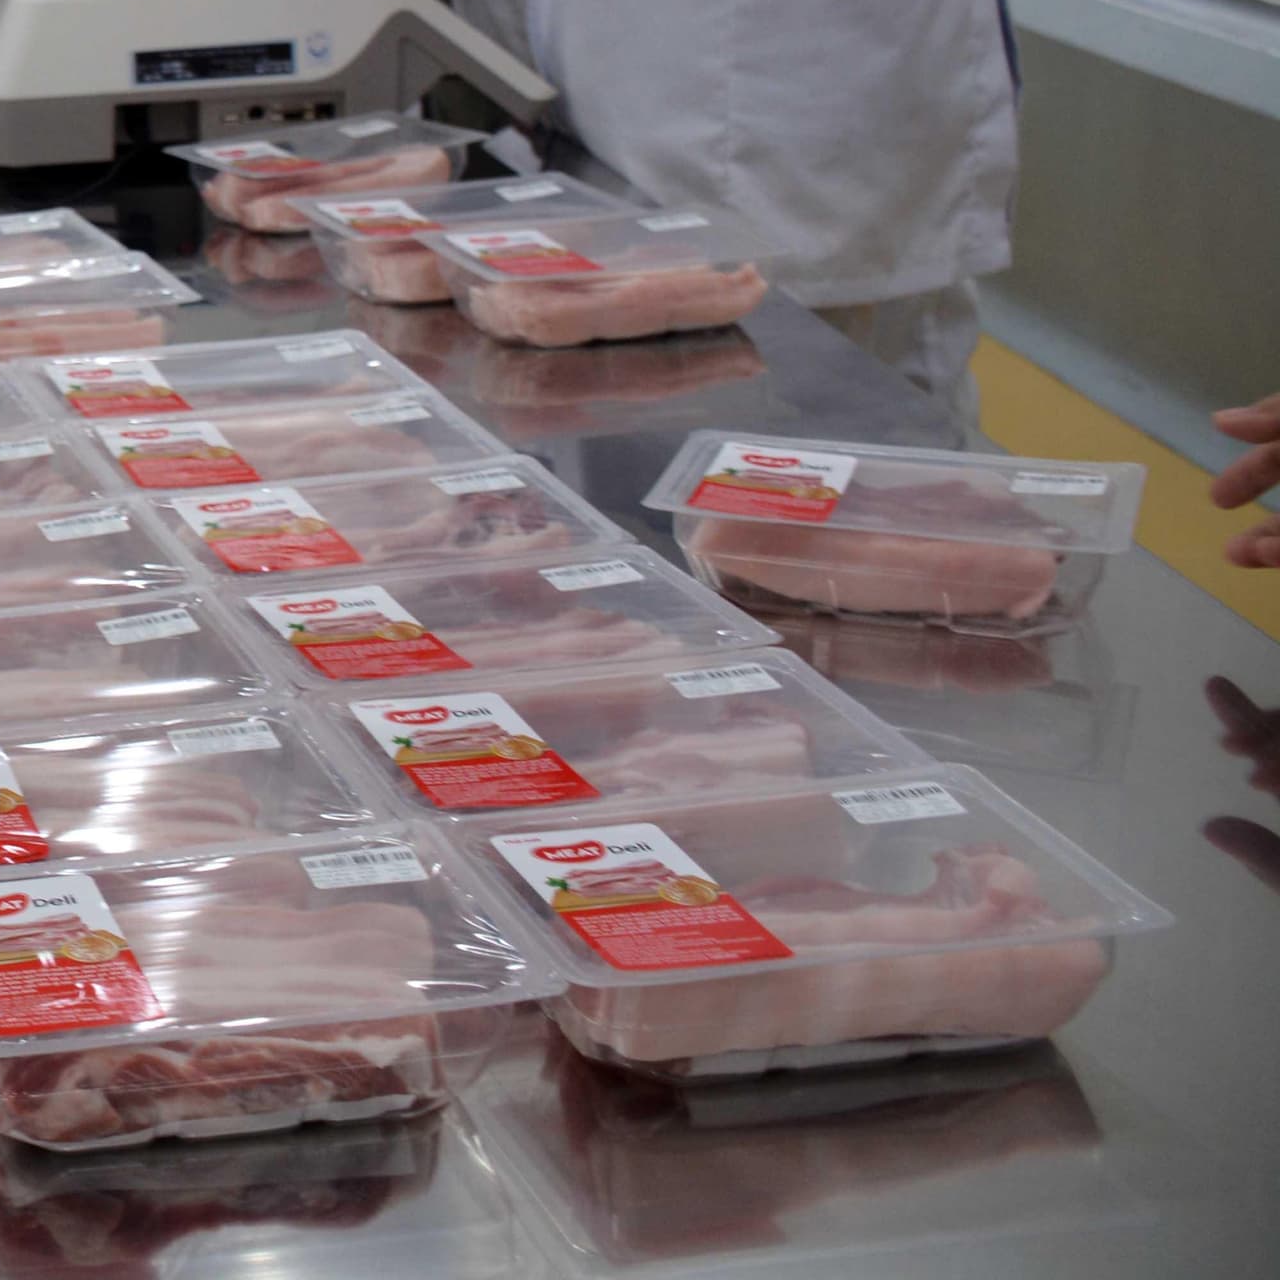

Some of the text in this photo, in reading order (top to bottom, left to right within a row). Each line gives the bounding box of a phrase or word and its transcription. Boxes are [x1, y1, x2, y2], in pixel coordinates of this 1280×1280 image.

[543, 841, 653, 861] MEAT Deli
[31, 894, 78, 909] Deli
